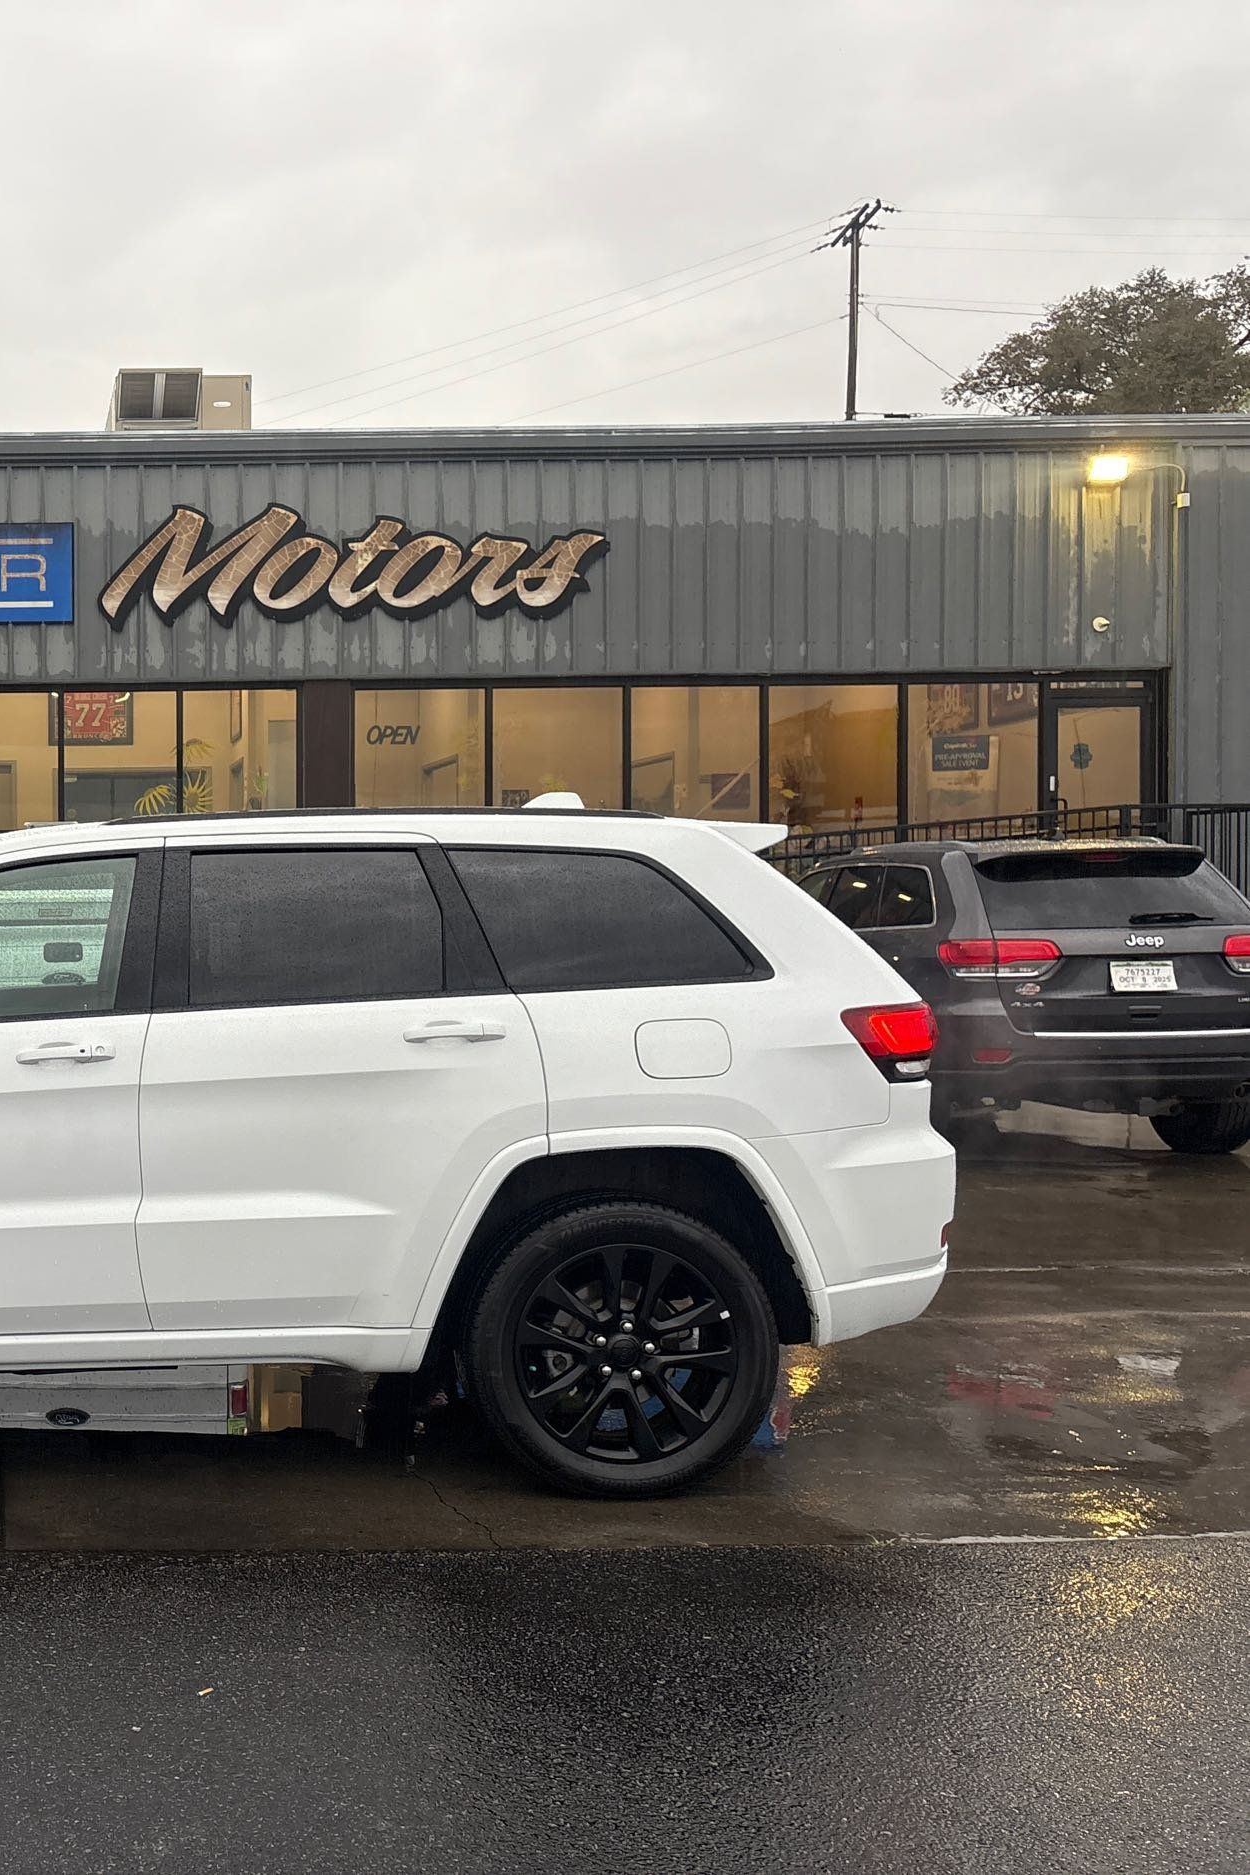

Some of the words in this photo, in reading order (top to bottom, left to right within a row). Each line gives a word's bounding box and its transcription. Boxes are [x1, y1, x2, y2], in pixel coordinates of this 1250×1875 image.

[100, 505, 607, 624] Motors
[74, 703, 107, 727] 77
[366, 725, 420, 745] OPEN
[1125, 934, 1165, 949] Jeep
[1154, 975, 1172, 983] 2025
